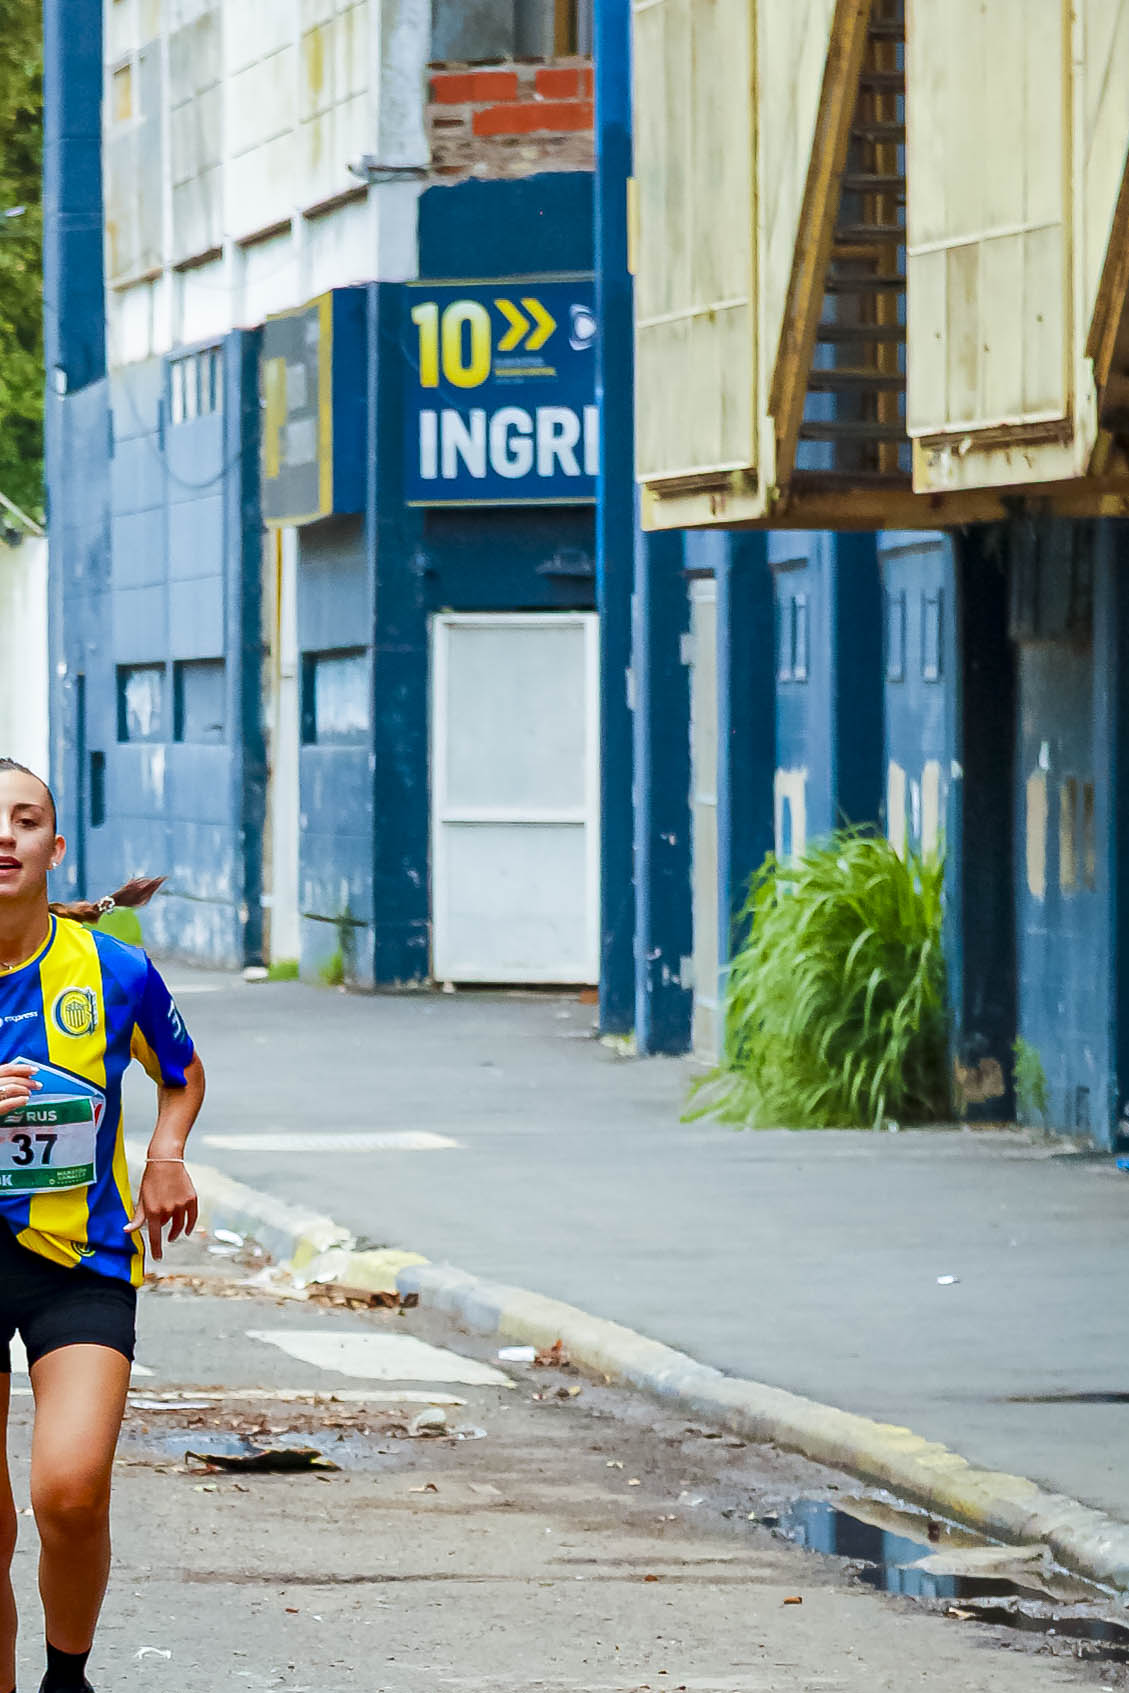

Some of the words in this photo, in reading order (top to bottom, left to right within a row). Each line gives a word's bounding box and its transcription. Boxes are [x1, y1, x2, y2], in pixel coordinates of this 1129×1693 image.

[411, 299, 492, 389] 10
[26, 1110, 58, 1122] RUS
[11, 1133, 58, 1166] 37
